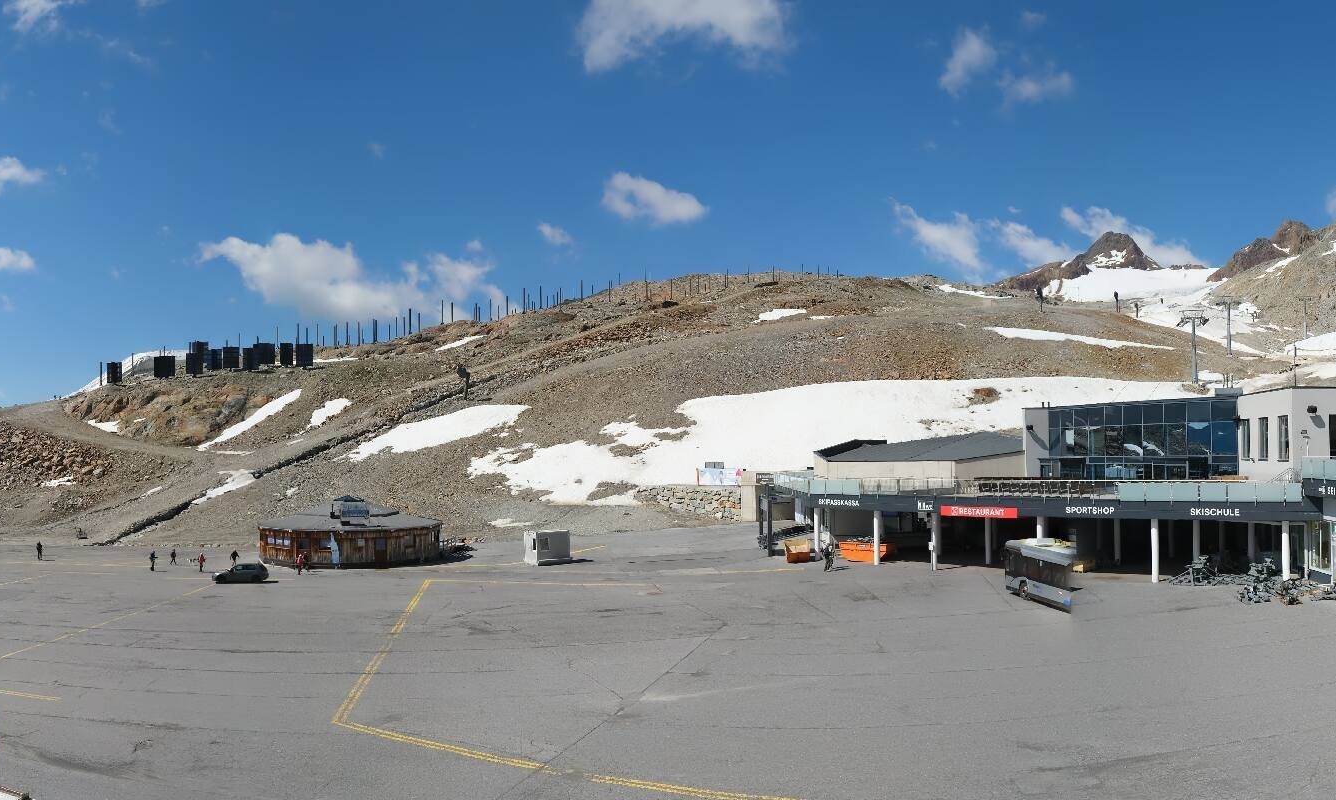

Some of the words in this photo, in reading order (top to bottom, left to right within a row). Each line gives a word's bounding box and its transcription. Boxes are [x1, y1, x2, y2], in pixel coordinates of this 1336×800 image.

[818, 498, 860, 507] SKIPASSKASSA
[958, 507, 1005, 516] RESTAURANT
[1065, 506, 1115, 515] SPORTSHOP
[1190, 507, 1240, 516] SKISCHULE
